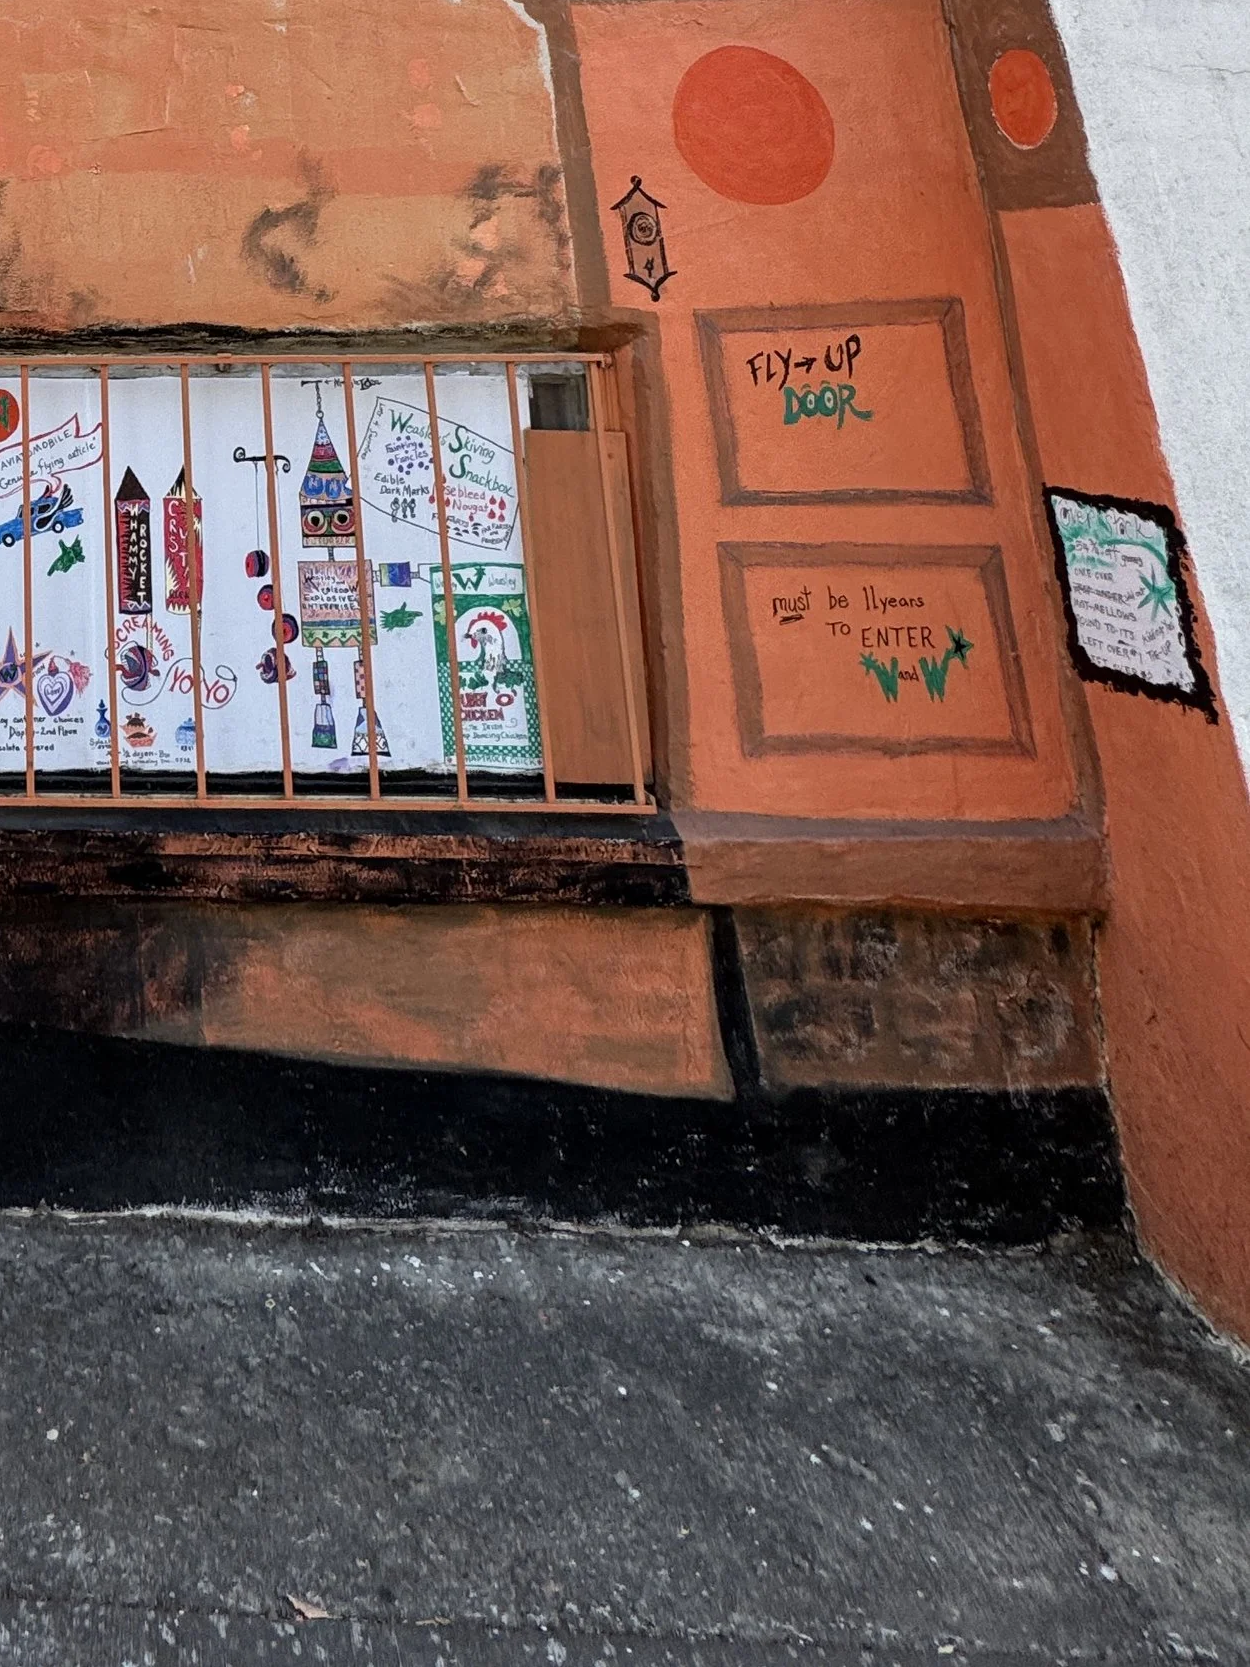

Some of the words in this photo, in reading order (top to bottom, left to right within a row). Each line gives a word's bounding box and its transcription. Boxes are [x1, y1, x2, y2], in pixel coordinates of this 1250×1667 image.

[824, 334, 862, 379] UP
[373, 472, 406, 485] Edible
[449, 454, 515, 498] Snackbox
[137, 524, 149, 604] ROCKET
[772, 585, 812, 617] must
[826, 585, 850, 610] be
[825, 620, 851, 637] TO
[861, 626, 936, 650] ENTER
[898, 666, 920, 683] and
